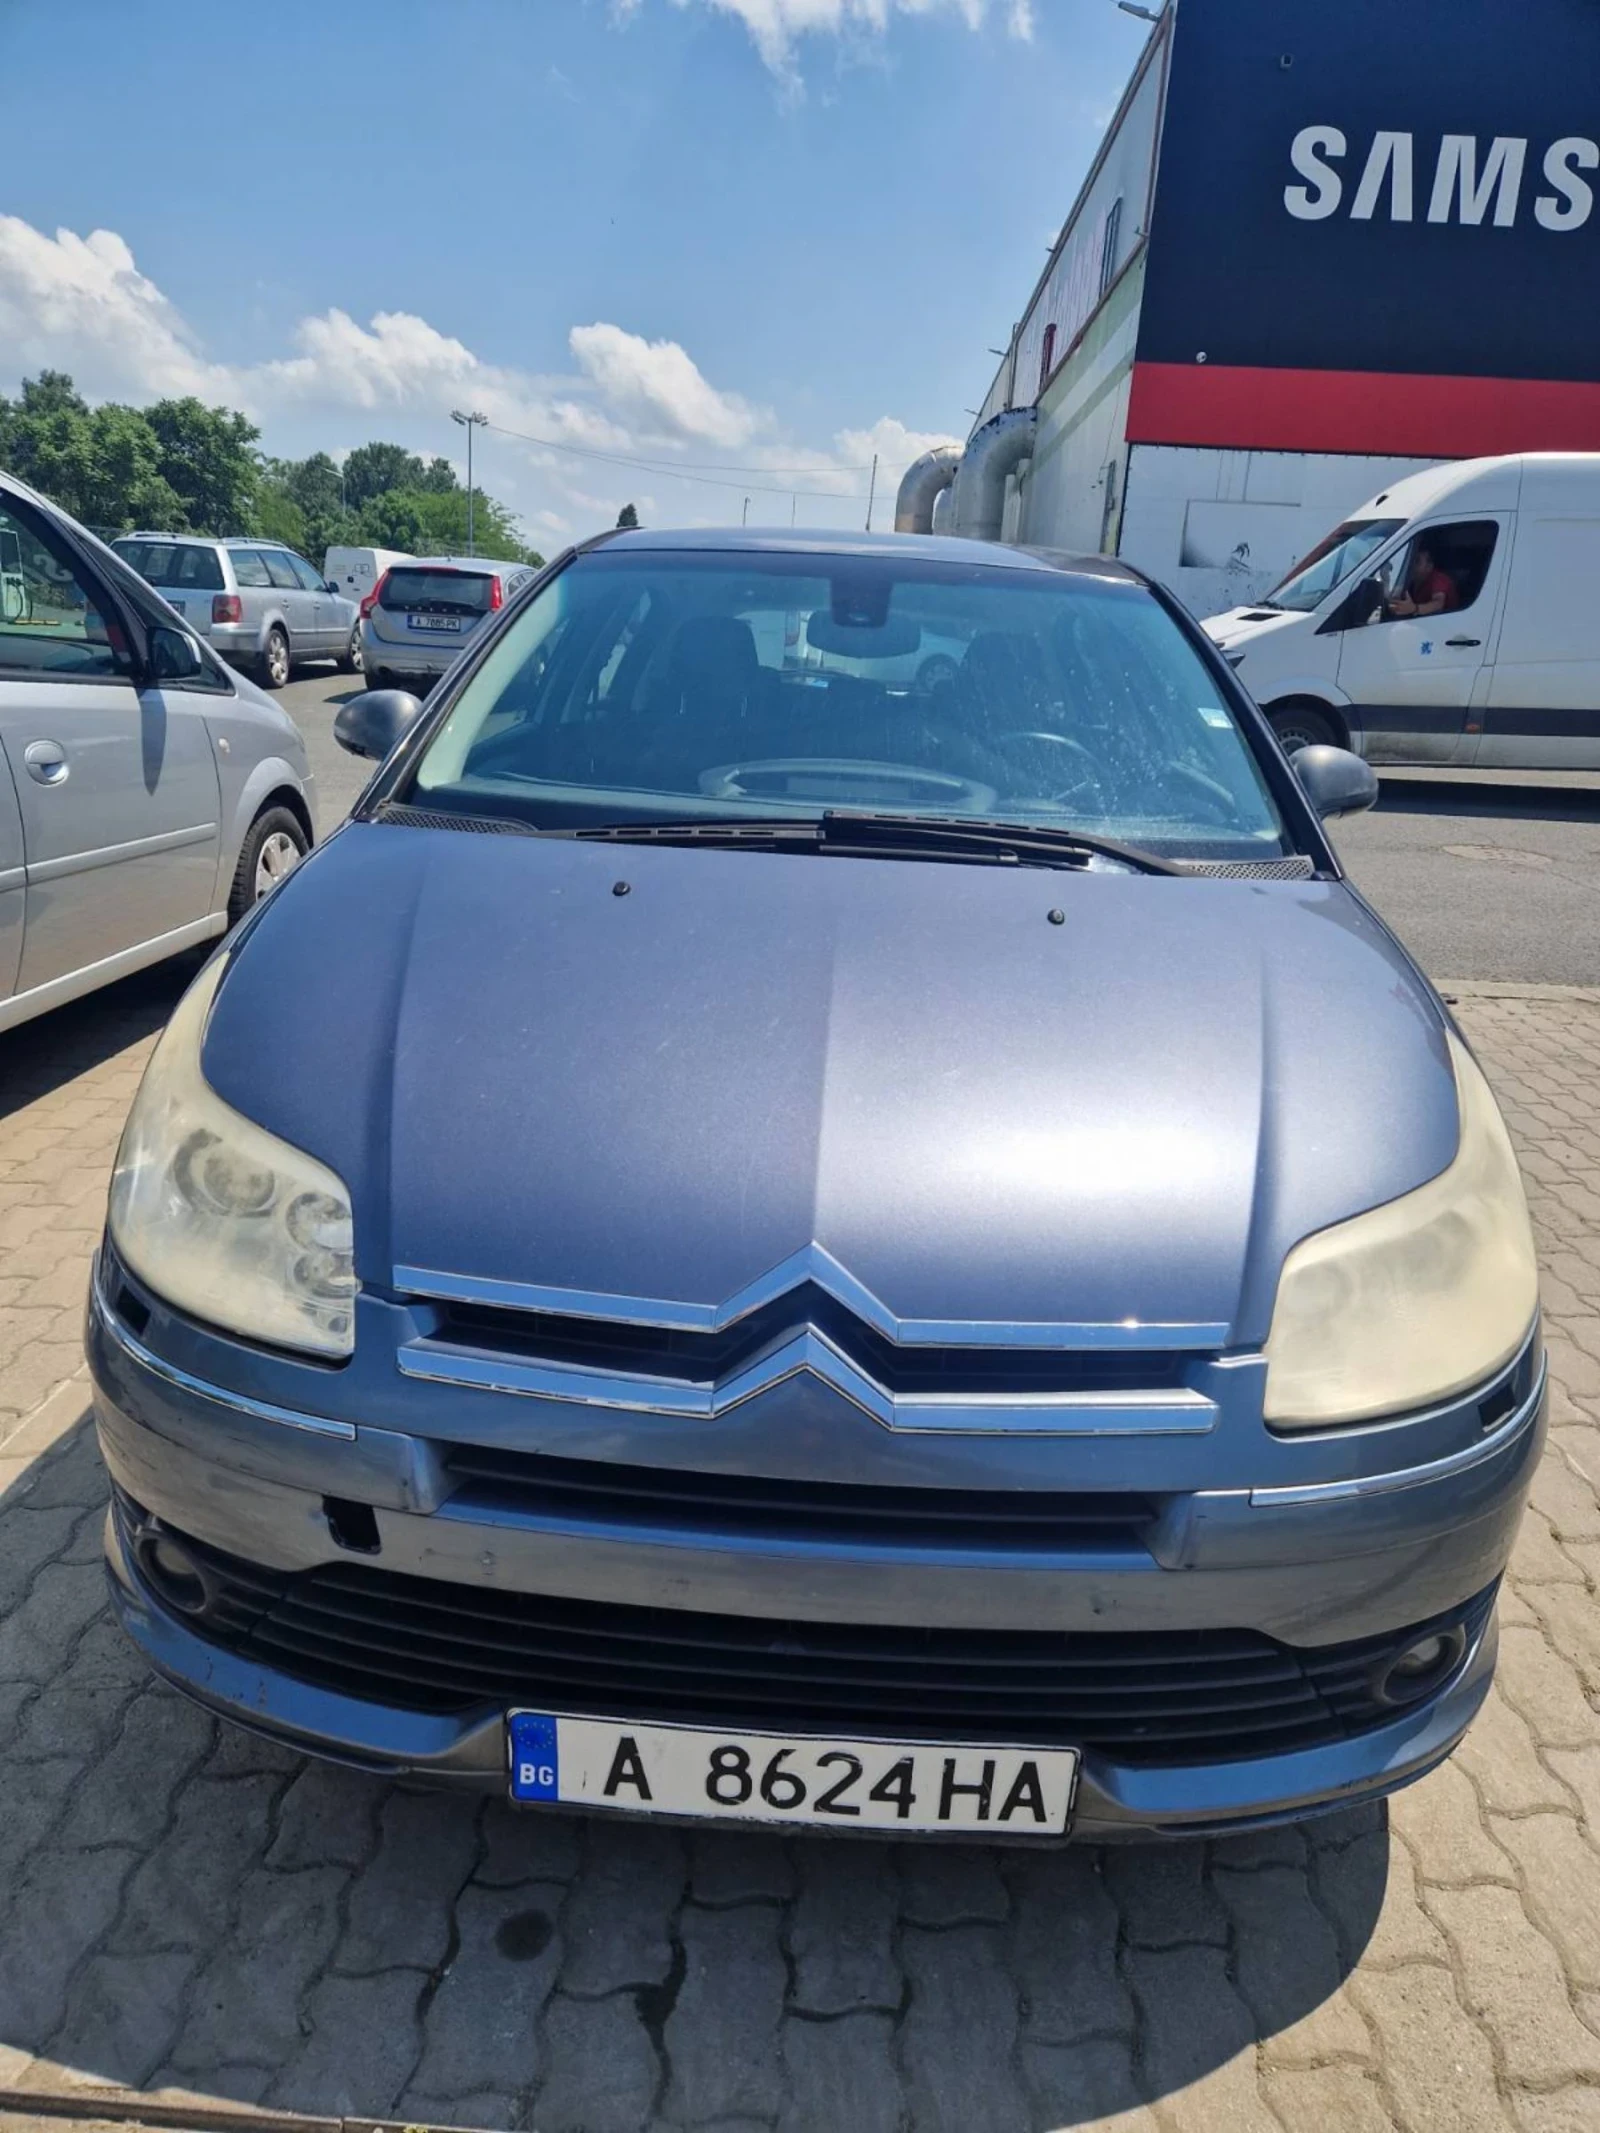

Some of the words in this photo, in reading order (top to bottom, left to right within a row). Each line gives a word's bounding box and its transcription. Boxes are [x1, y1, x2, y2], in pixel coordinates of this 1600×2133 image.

[1284, 125, 1600, 231] SAMS
[520, 1764, 554, 1785] BG
[603, 1736, 653, 1801] A
